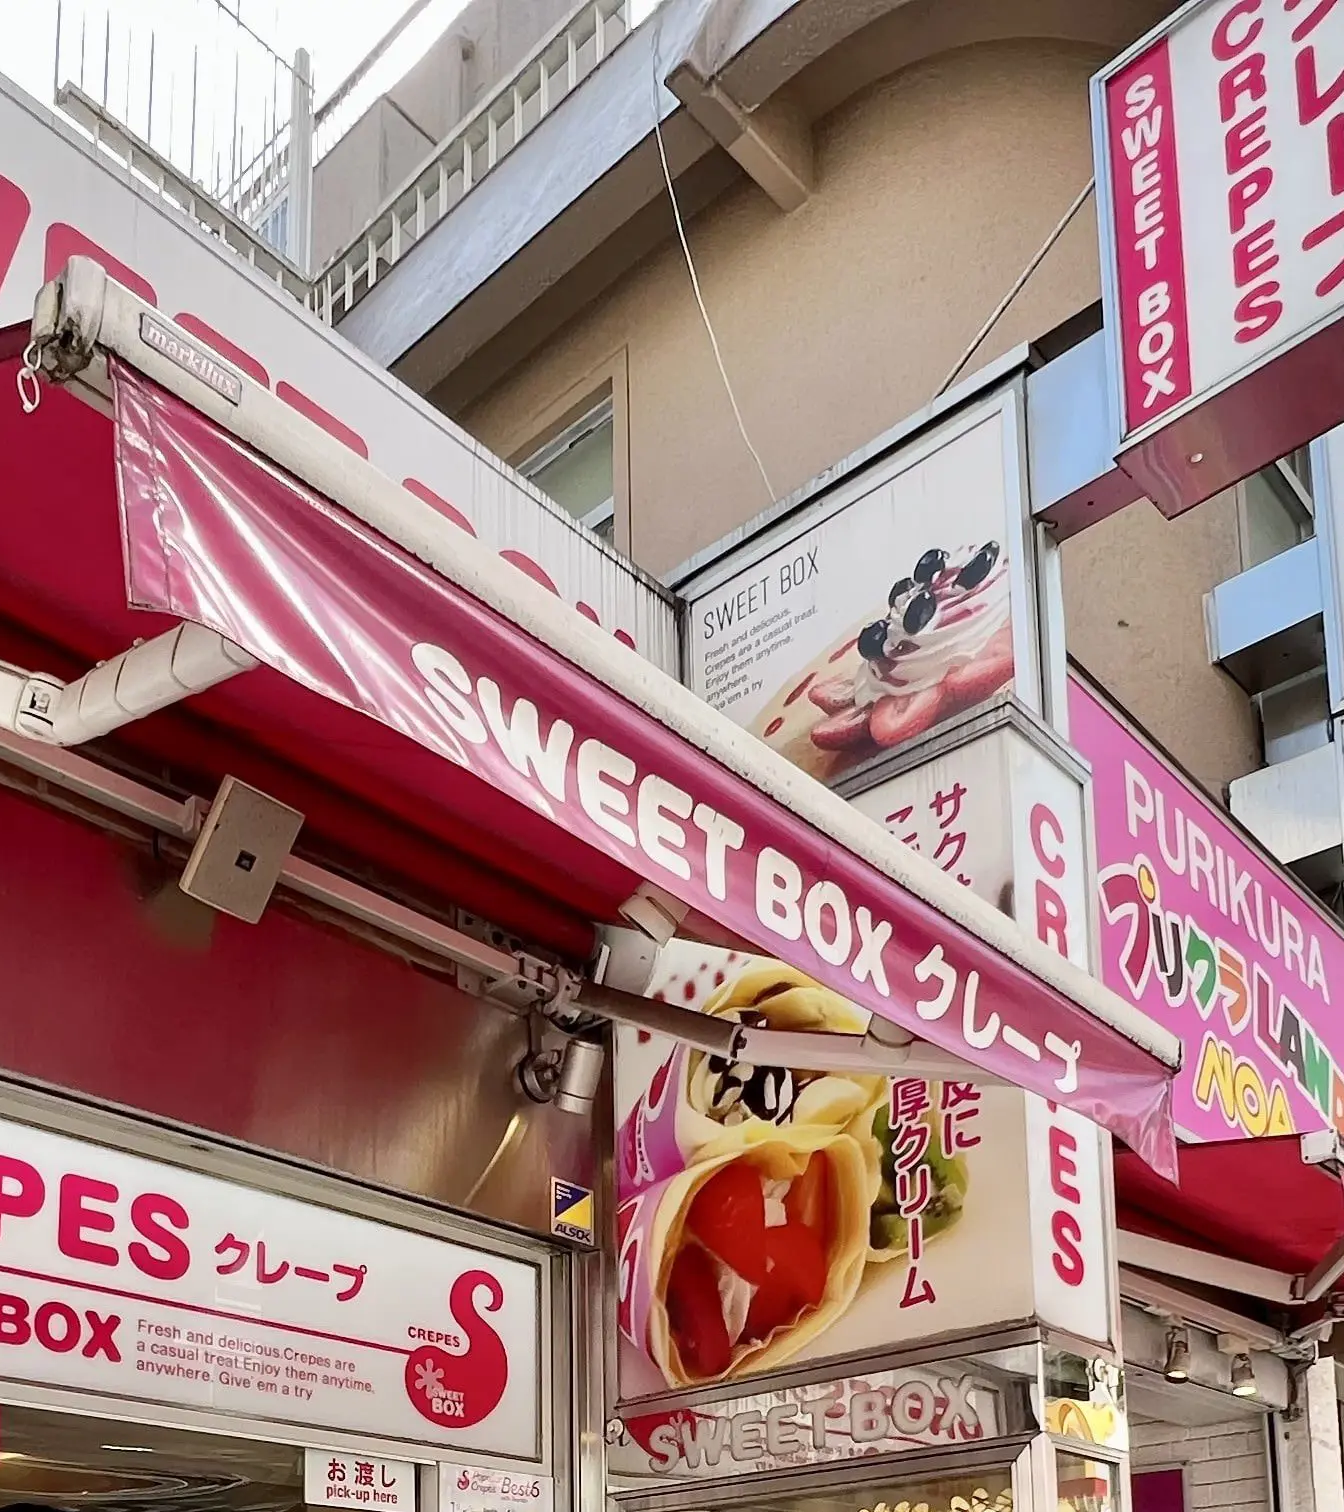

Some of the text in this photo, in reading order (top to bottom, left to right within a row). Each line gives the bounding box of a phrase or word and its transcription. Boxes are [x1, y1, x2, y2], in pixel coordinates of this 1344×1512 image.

[1212, 0, 1283, 345] CREPES
[1121, 74, 1175, 409] SWEET BOX
[143, 318, 240, 401] markilux
[703, 545, 819, 640] SWEET BOX
[731, 631, 748, 647] and
[705, 653, 736, 676] Crepes
[705, 671, 730, 690] Enjoy
[411, 642, 1080, 1093] SWEET BOX クレープ
[1124, 760, 1331, 1004] PURIKURA
[1193, 1032, 1294, 1138] NOA
[554, 1223, 591, 1242] ALSOK
[214, 1233, 369, 1302] クレープ
[136, 1339, 146, 1352] a
[150, 1342, 199, 1361] casual
[285, 1365, 318, 1384] them
[137, 1319, 181, 1340] Fresh
[187, 1330, 214, 1346] and
[334, 1359, 356, 1373] are
[407, 1326, 461, 1348] CREPES
[136, 1358, 214, 1384] anywhere.
[282, 1384, 290, 1396] a
[294, 1385, 313, 1401] try
[431, 1397, 465, 1418] BOX
[649, 1375, 978, 1474] SWEET BOX
[325, 1483, 398, 1505] pick-up here
[327, 1458, 397, 1488] お渡し
